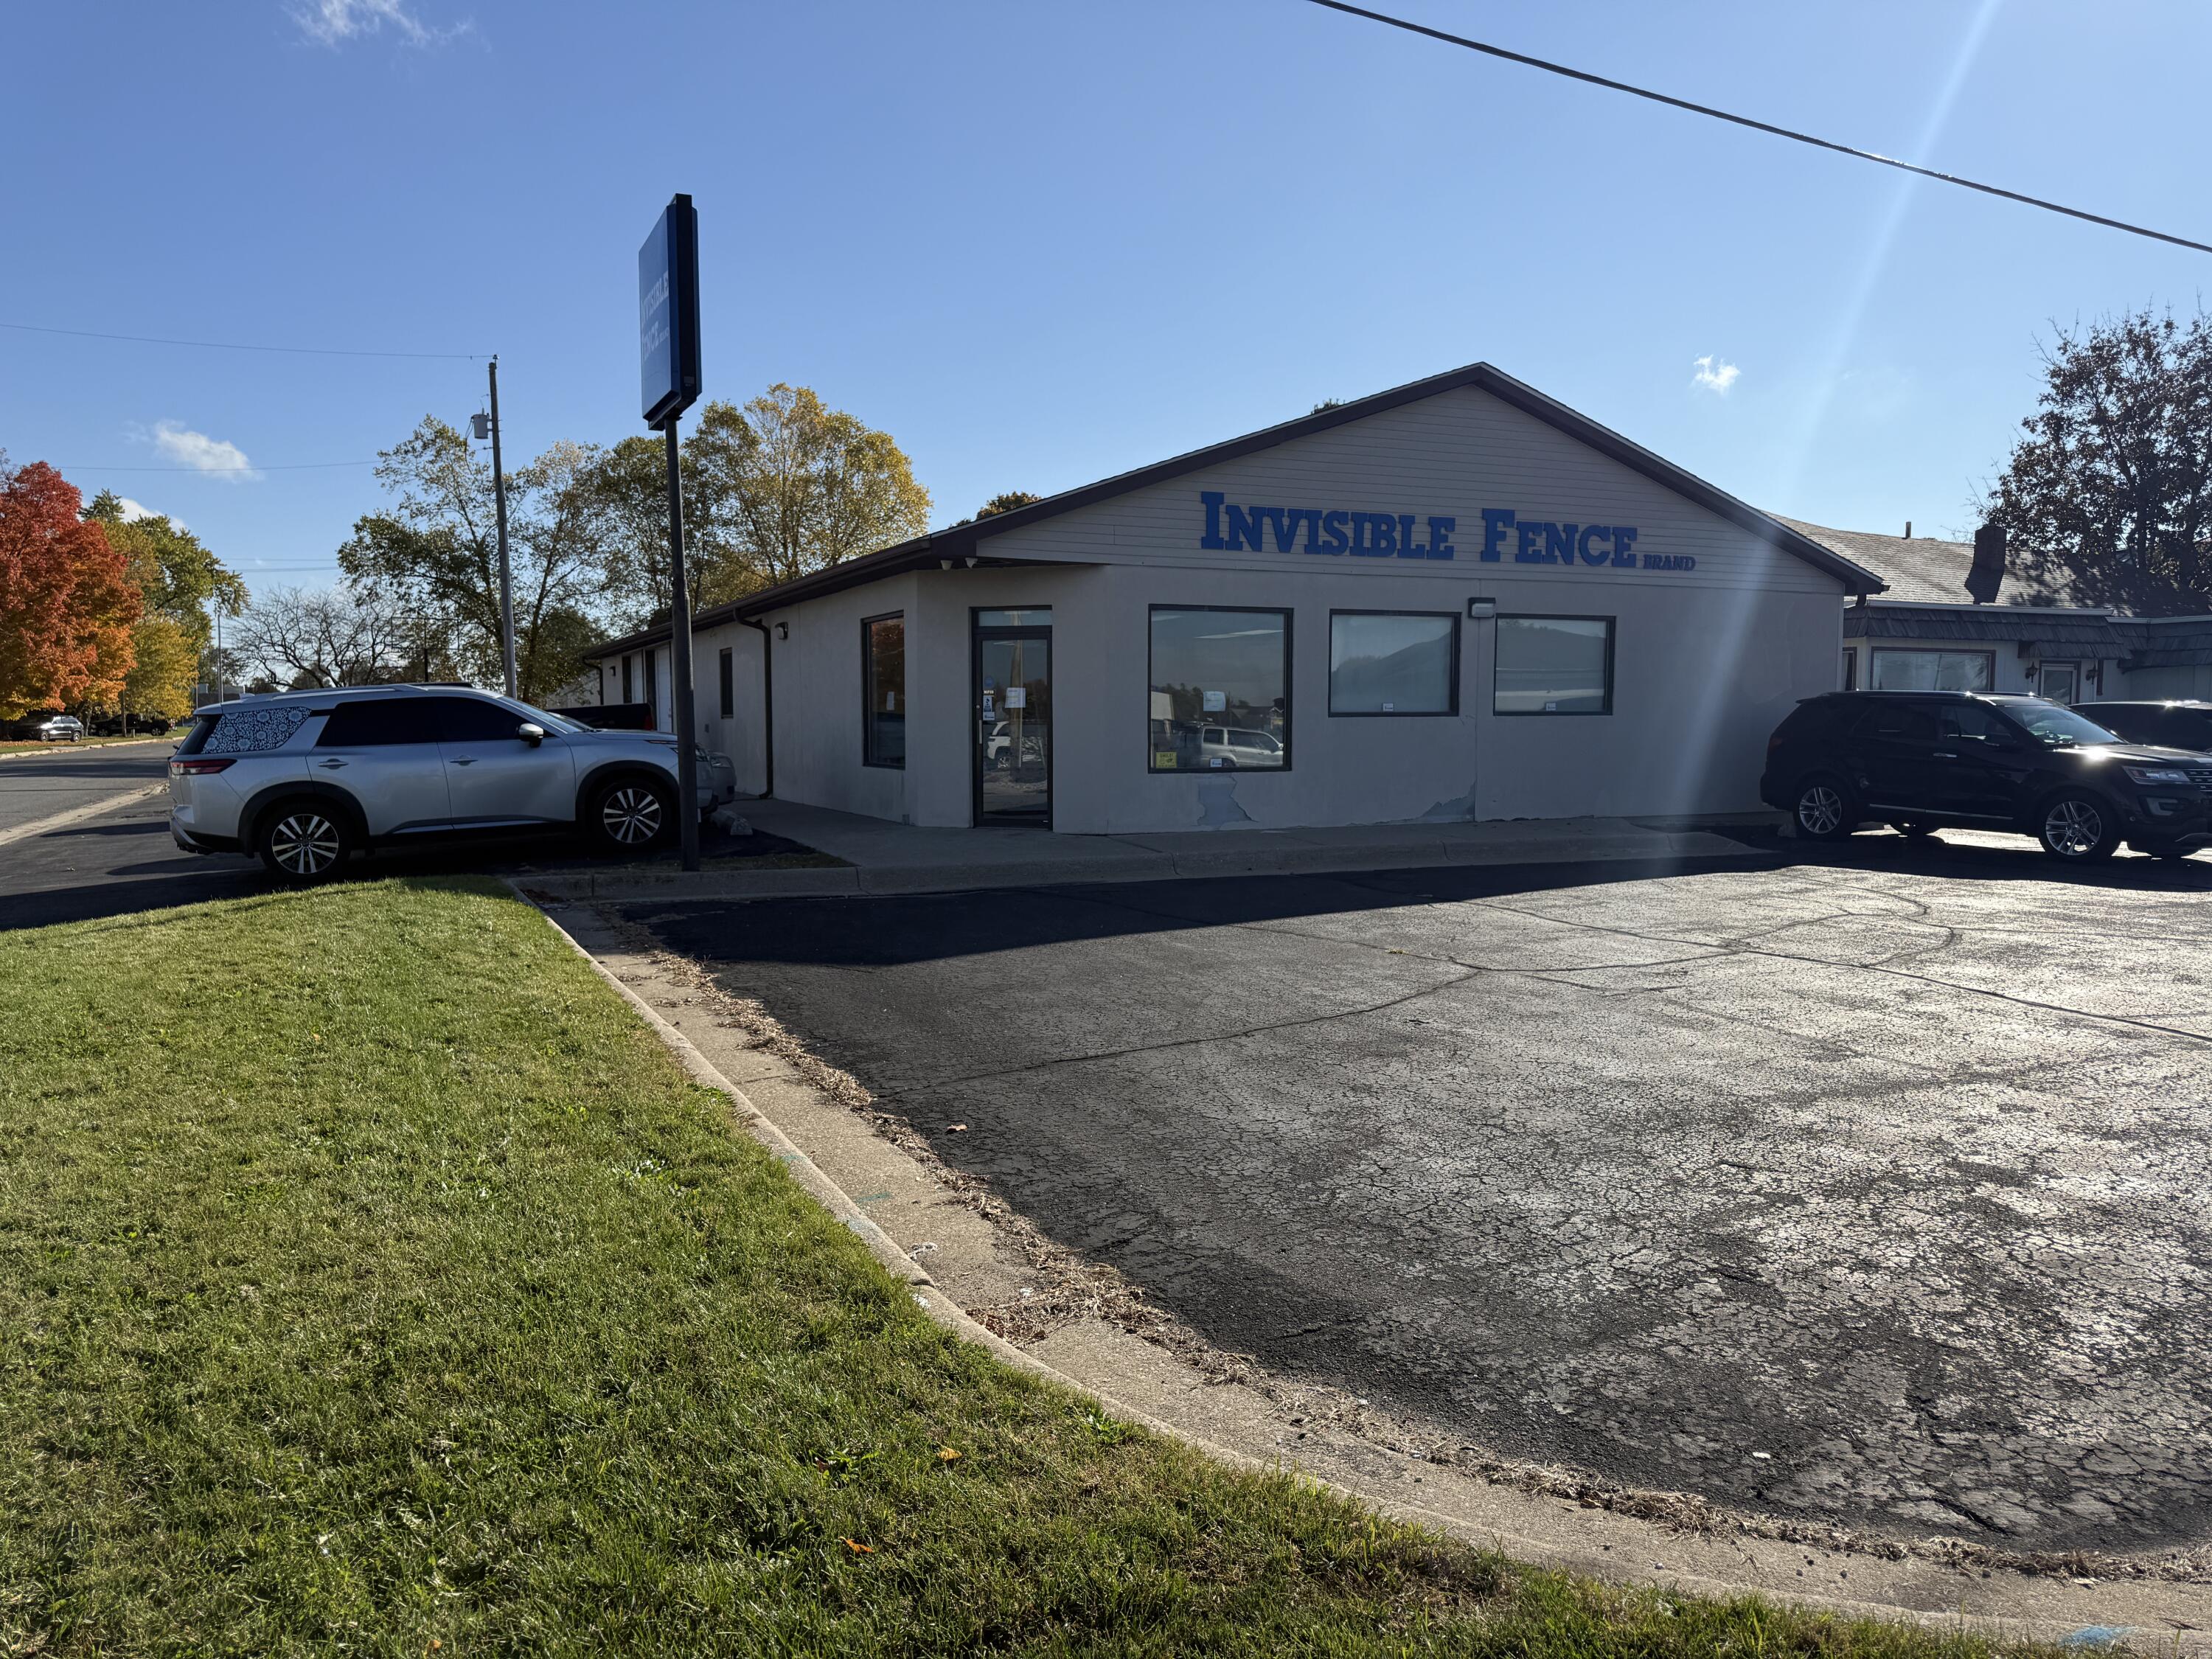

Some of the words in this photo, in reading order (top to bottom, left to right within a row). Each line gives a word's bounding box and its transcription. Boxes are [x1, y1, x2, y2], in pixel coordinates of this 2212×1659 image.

[1200, 491, 1455, 560] INVISIBLE
[1481, 508, 1638, 568] FENCE
[1643, 554, 1697, 571] BRAND
